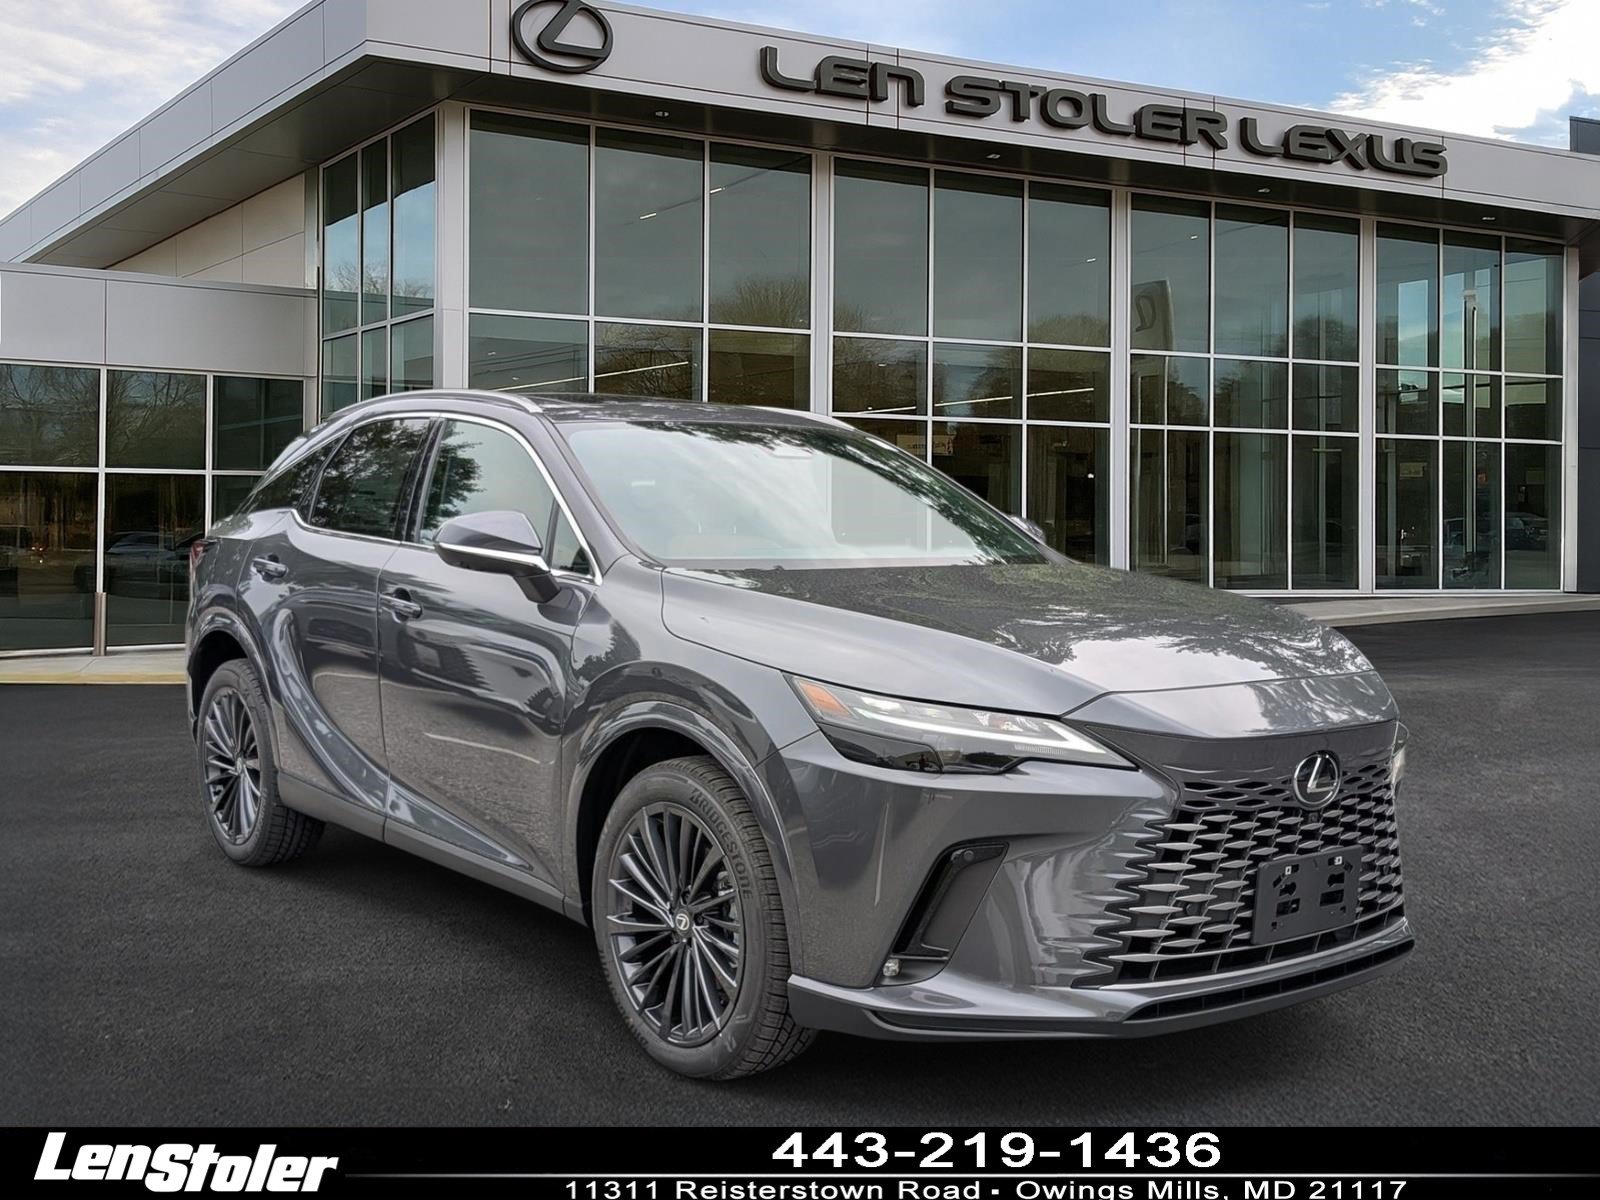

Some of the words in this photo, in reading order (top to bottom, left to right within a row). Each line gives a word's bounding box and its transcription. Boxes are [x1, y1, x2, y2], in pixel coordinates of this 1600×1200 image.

[760, 46, 925, 107] LEN
[945, 75, 1228, 149] STOLER
[1239, 117, 1448, 177] LEXUS
[689, 787, 753, 901] BRIDGESTONE
